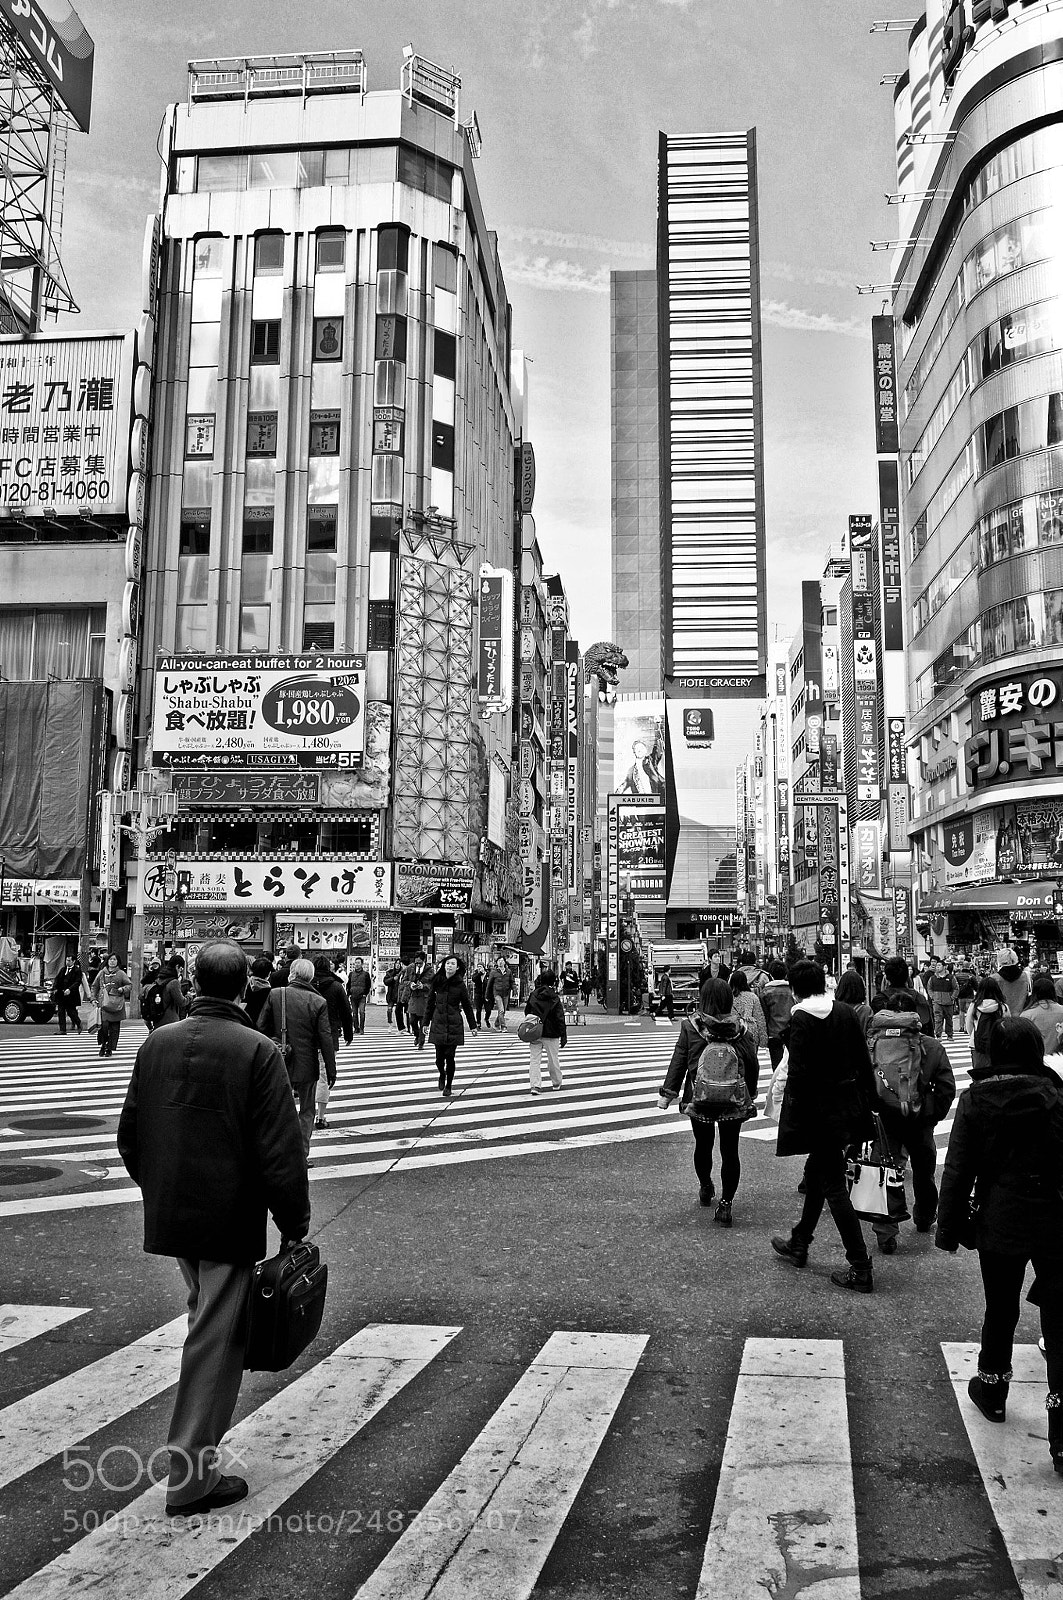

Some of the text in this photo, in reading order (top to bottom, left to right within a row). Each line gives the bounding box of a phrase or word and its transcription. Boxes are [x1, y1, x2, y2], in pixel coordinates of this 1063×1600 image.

[877, 343, 894, 422] 驚安の殿堂
[0, 480, 110, 501] 120-81-4060
[160, 656, 363, 671] All-you-can-eat buffet for 2 hours
[484, 647, 497, 694] ひょうたん
[163, 675, 262, 694] しゃぶしゃぶ
[679, 678, 752, 687] HOTEL GRACERY
[979, 678, 1057, 721] 驚安の
[274, 700, 351, 728] 1,980 yen
[860, 708, 874, 745] 居楽屋
[215, 737, 244, 749] 2,480
[302, 737, 330, 748] 1,480
[338, 752, 361, 766] 5F
[858, 748, 878, 784] 笑笑
[860, 828, 876, 885] カラオケ
[232, 865, 364, 898] とらそば
[608, 816, 618, 928] GODZILLA ROAD
[3, 882, 33, 903] 営業中
[524, 866, 535, 908] トラノコ
[896, 889, 907, 935] カラオケ
[1016, 895, 1041, 905] Don
[144, 916, 229, 928] んこつラーメン
[297, 929, 348, 944] とらそば
